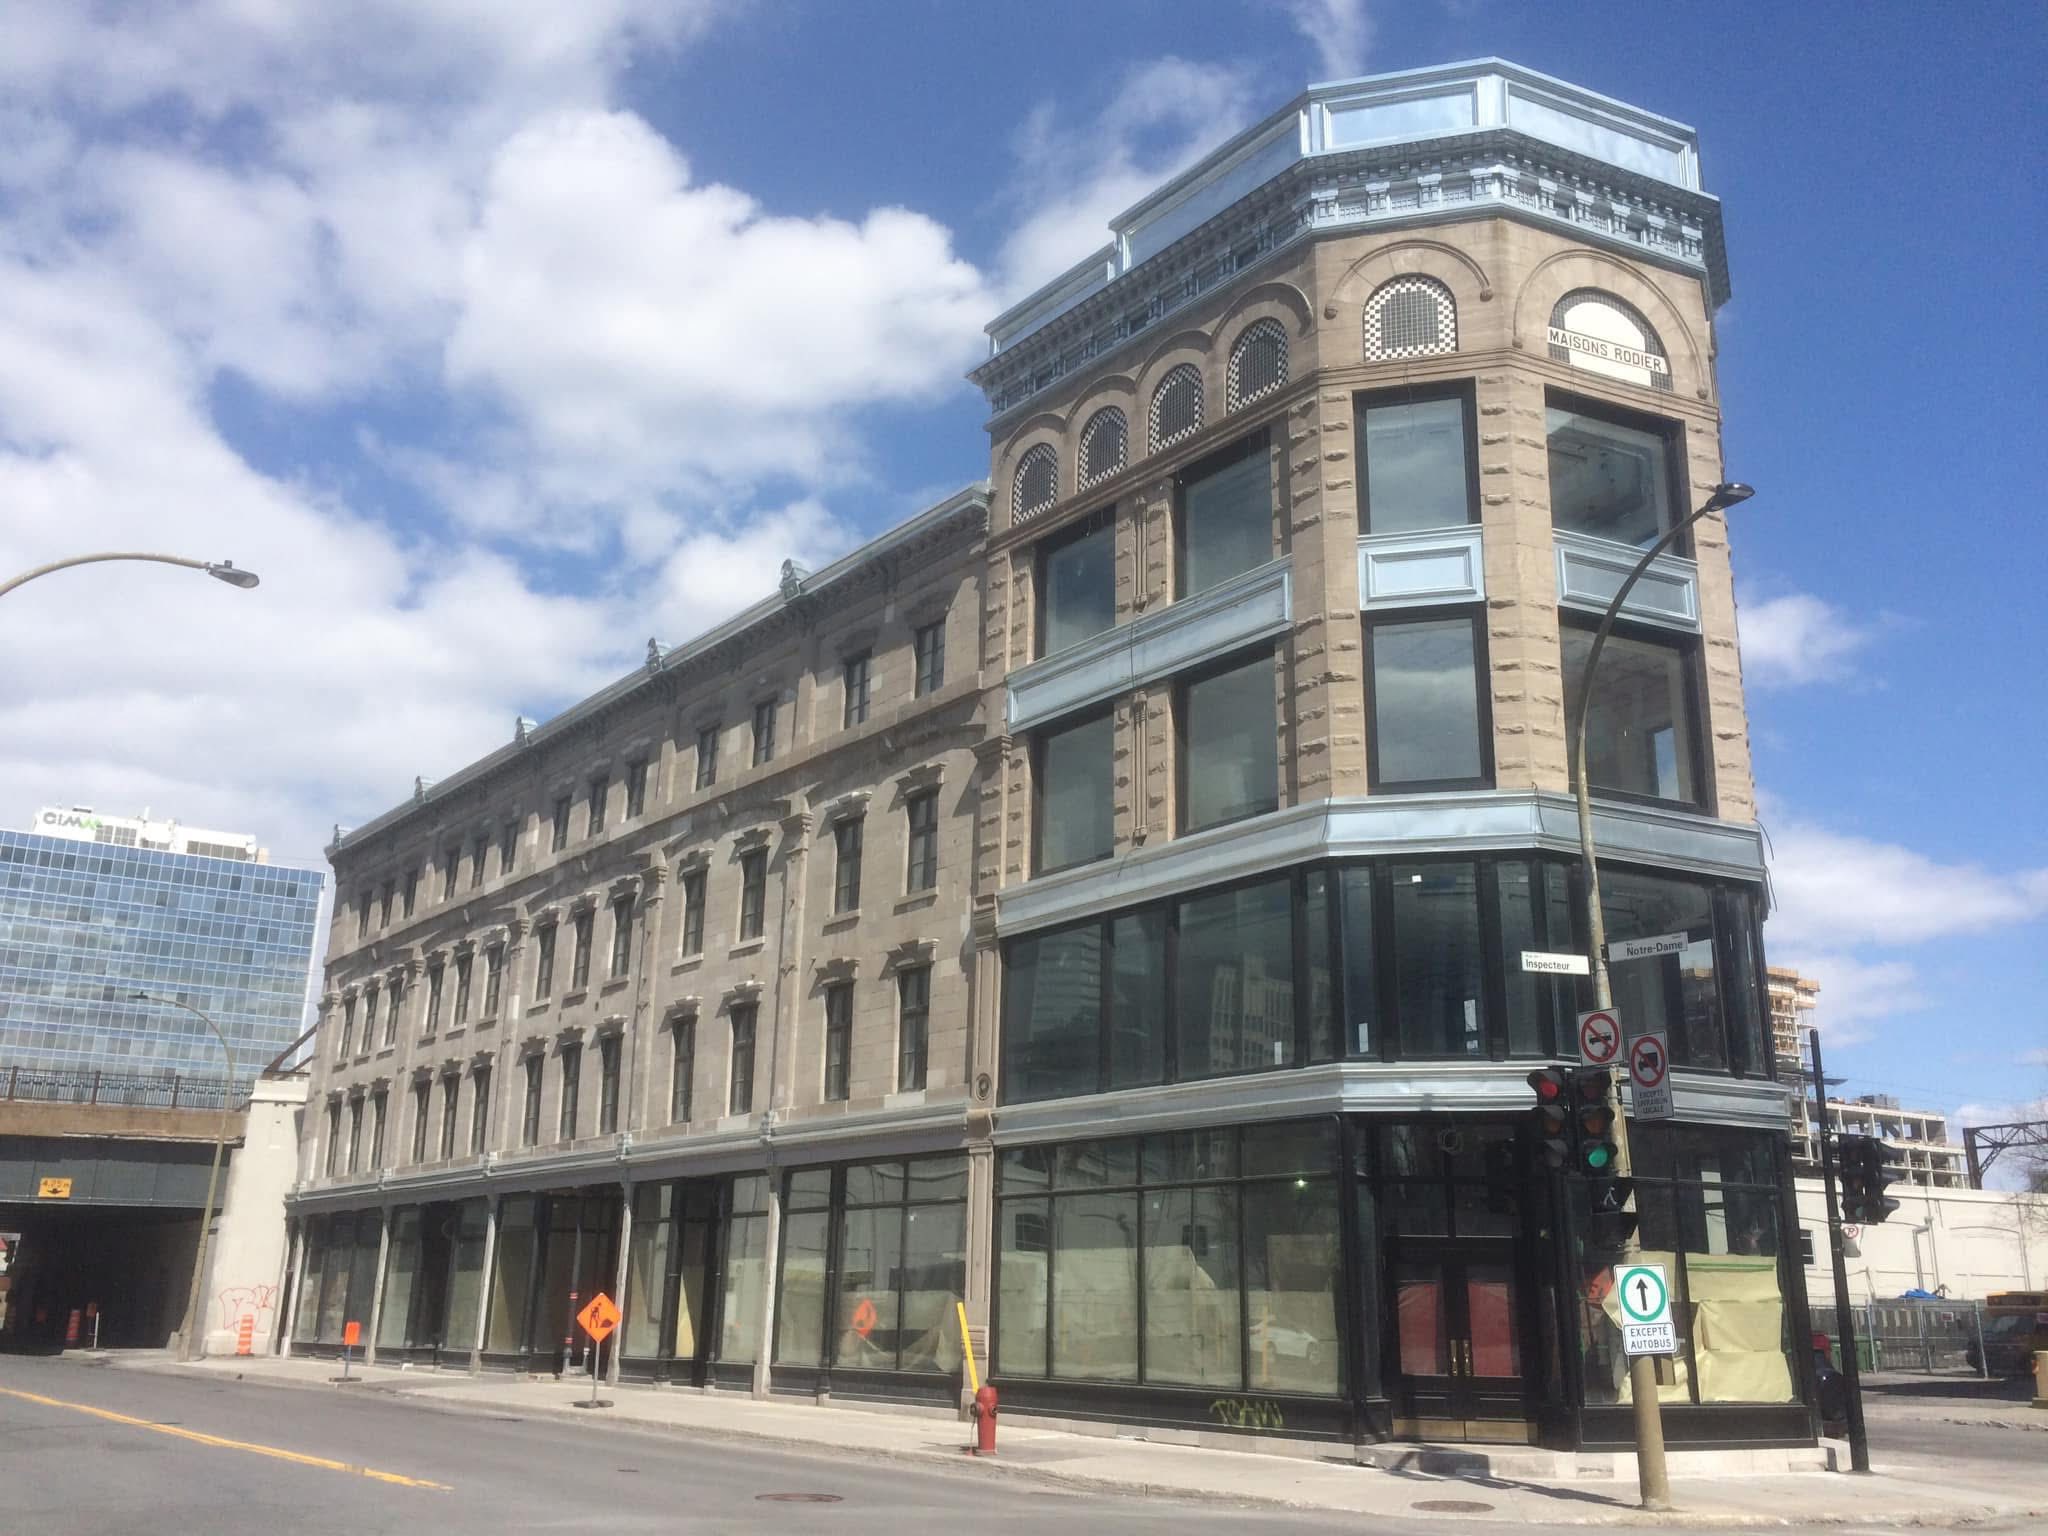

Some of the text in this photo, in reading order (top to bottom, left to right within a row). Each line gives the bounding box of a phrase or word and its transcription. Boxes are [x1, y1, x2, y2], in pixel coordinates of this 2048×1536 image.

[1549, 329, 1662, 372] MAISONS RODIER
[1626, 942, 1683, 957] Notre-Dame
[1525, 959, 1570, 971] Inspecteur
[1630, 1339, 1672, 1350] AUTOBUS
